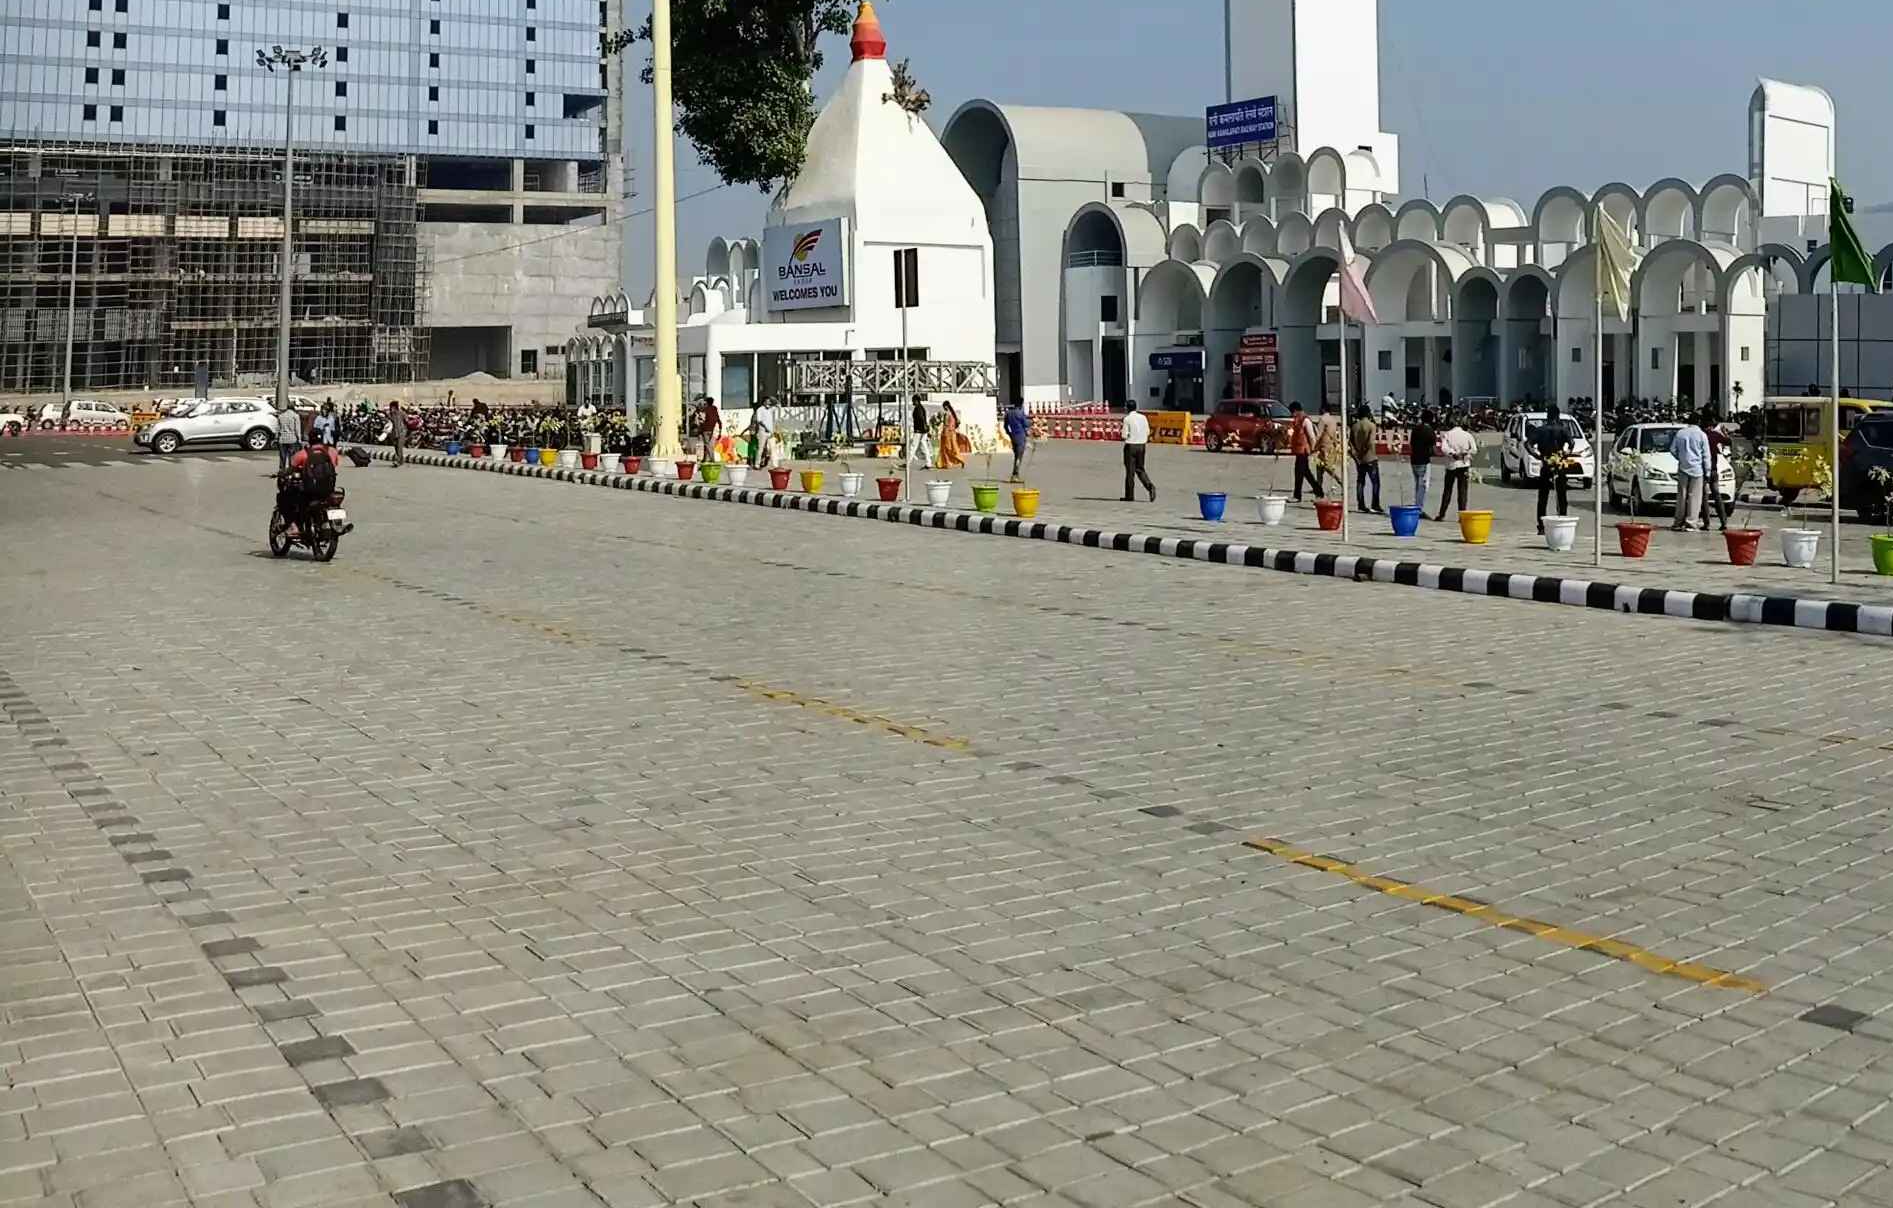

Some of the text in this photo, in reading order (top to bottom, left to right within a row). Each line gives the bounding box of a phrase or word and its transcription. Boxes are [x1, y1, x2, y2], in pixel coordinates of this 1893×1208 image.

[779, 262, 826, 279] BANSAL
[773, 285, 837, 301] WELCOMES YOU
